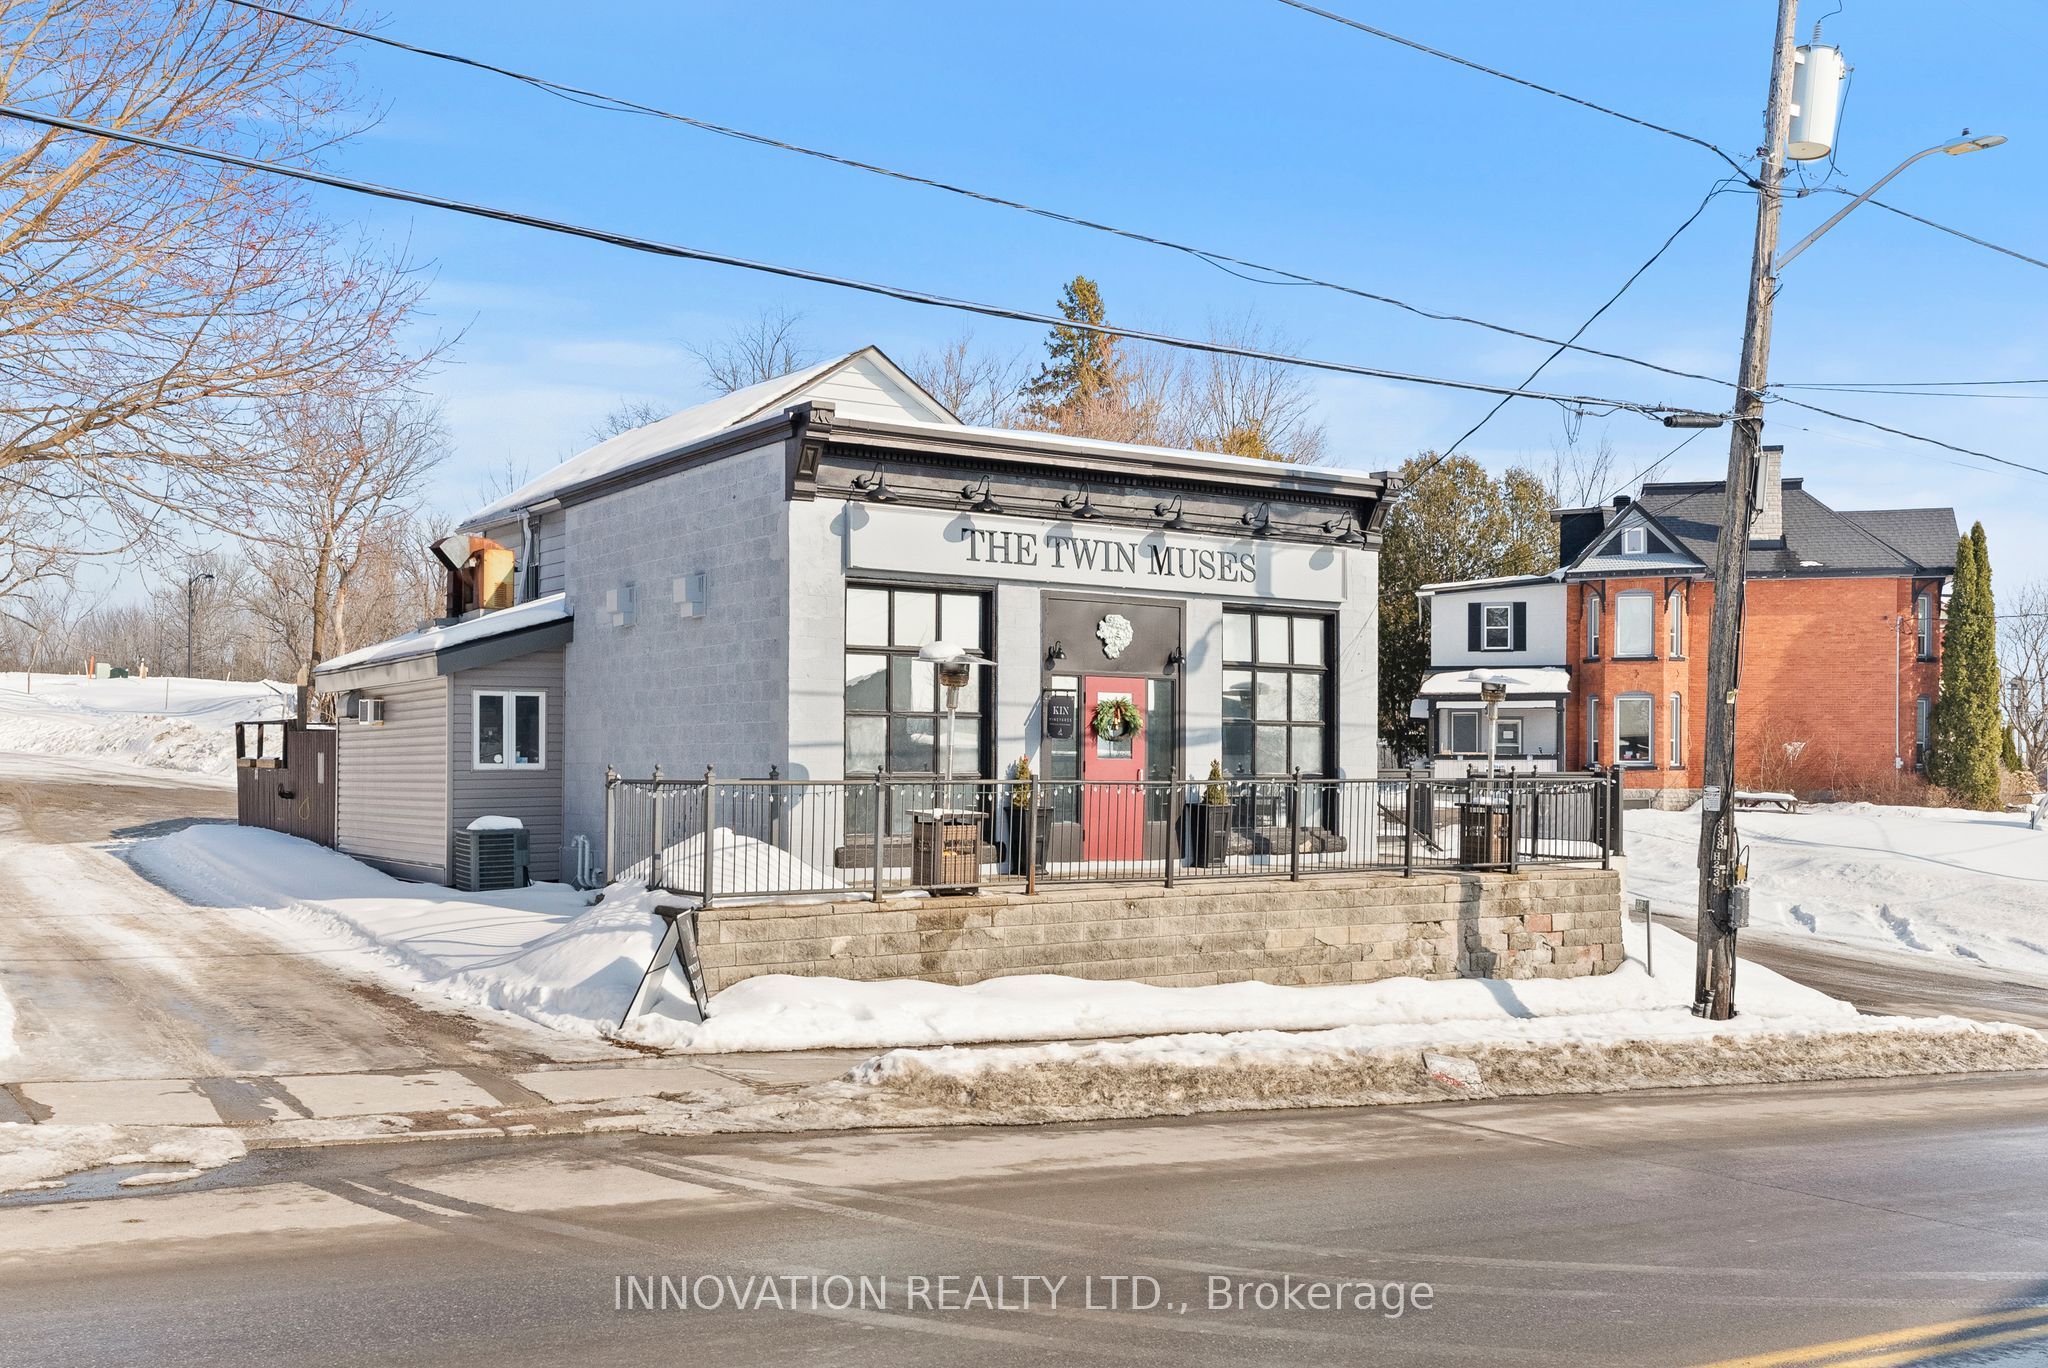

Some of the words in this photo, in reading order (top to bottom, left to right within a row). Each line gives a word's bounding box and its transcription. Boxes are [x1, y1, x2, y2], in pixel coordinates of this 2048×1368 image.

[961, 527, 1037, 566] THE
[1047, 535, 1138, 574] TWIN
[1147, 544, 1257, 583] MUSES
[1053, 706, 1069, 715] KIN
